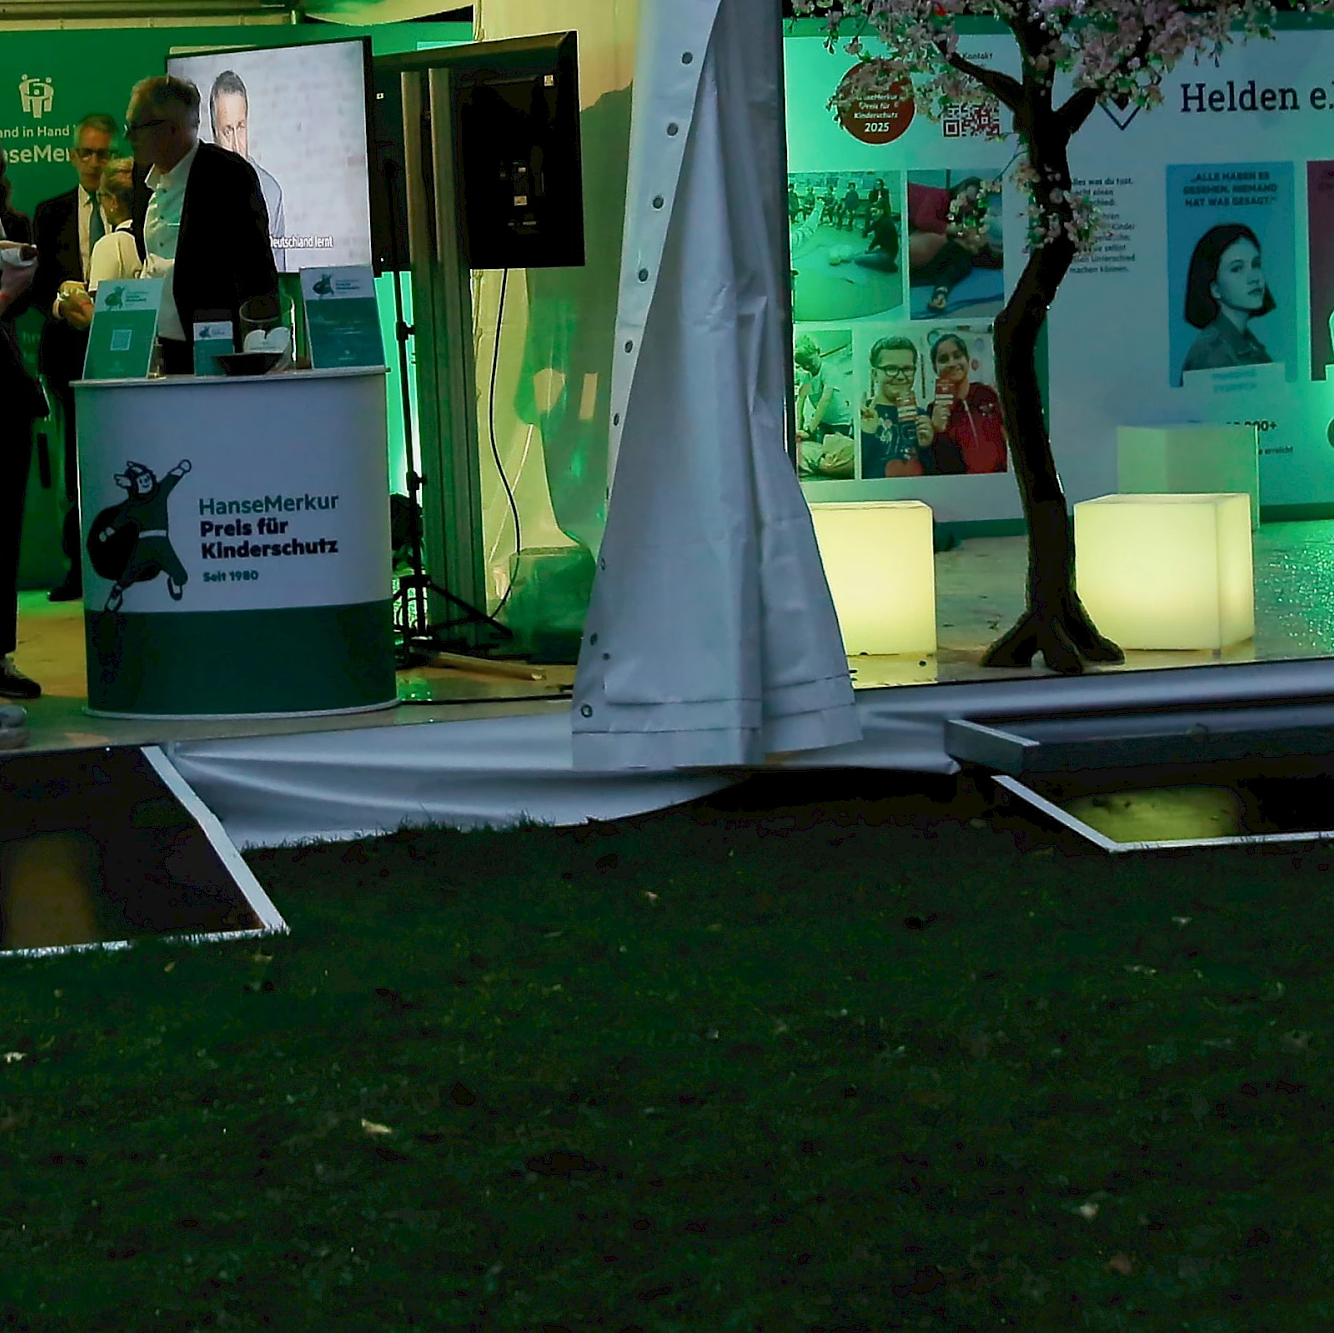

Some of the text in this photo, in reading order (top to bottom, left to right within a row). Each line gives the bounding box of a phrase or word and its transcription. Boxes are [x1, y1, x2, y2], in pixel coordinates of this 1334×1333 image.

[1180, 80, 1300, 113] Helden
[22, 126, 34, 138] in
[36, 124, 70, 137] Hand
[864, 122, 890, 133] 2025
[198, 493, 339, 516] HanseMerkur
[200, 516, 289, 537] Preis für
[201, 538, 339, 560] Kinderschutz
[203, 569, 260, 582] Seit 1980
